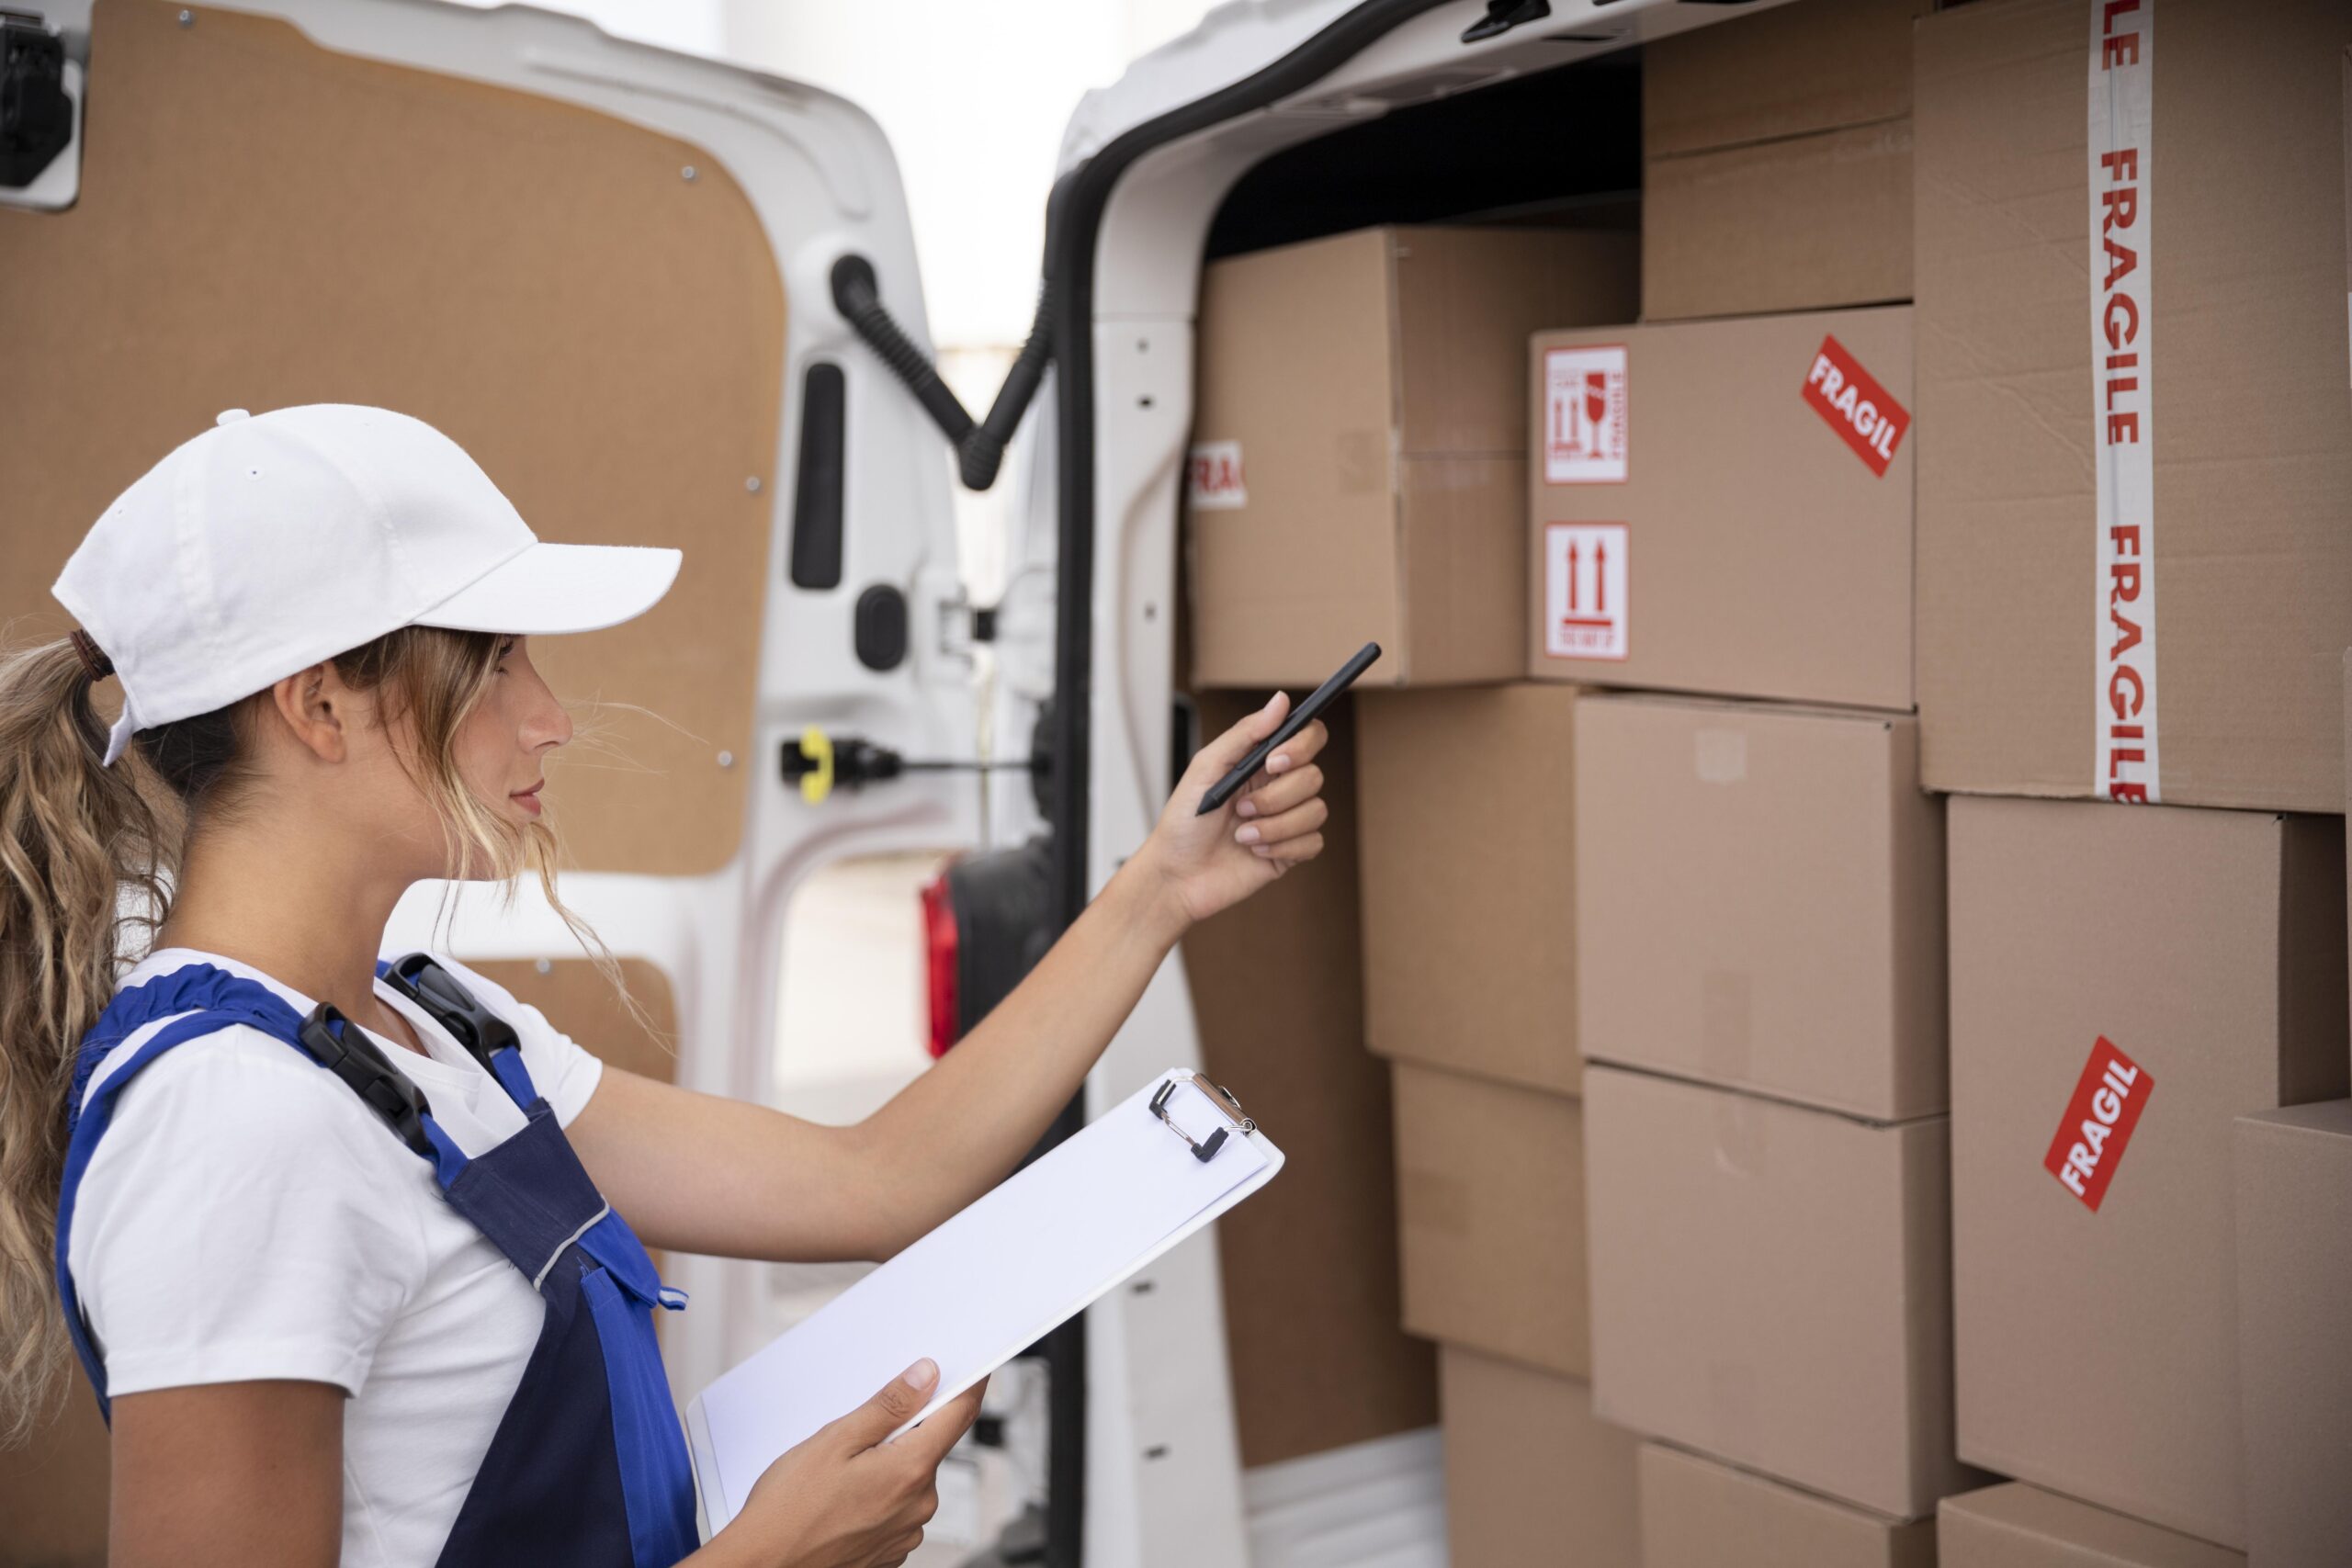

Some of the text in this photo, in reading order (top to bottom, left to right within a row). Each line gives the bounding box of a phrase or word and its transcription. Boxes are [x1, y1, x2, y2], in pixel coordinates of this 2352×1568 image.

[2102, 0, 2141, 71] LE
[2101, 148, 2139, 446] FRAGILE
[1808, 353, 1896, 460] FRAGIL
[2059, 1059, 2139, 1197] FRAGIL
